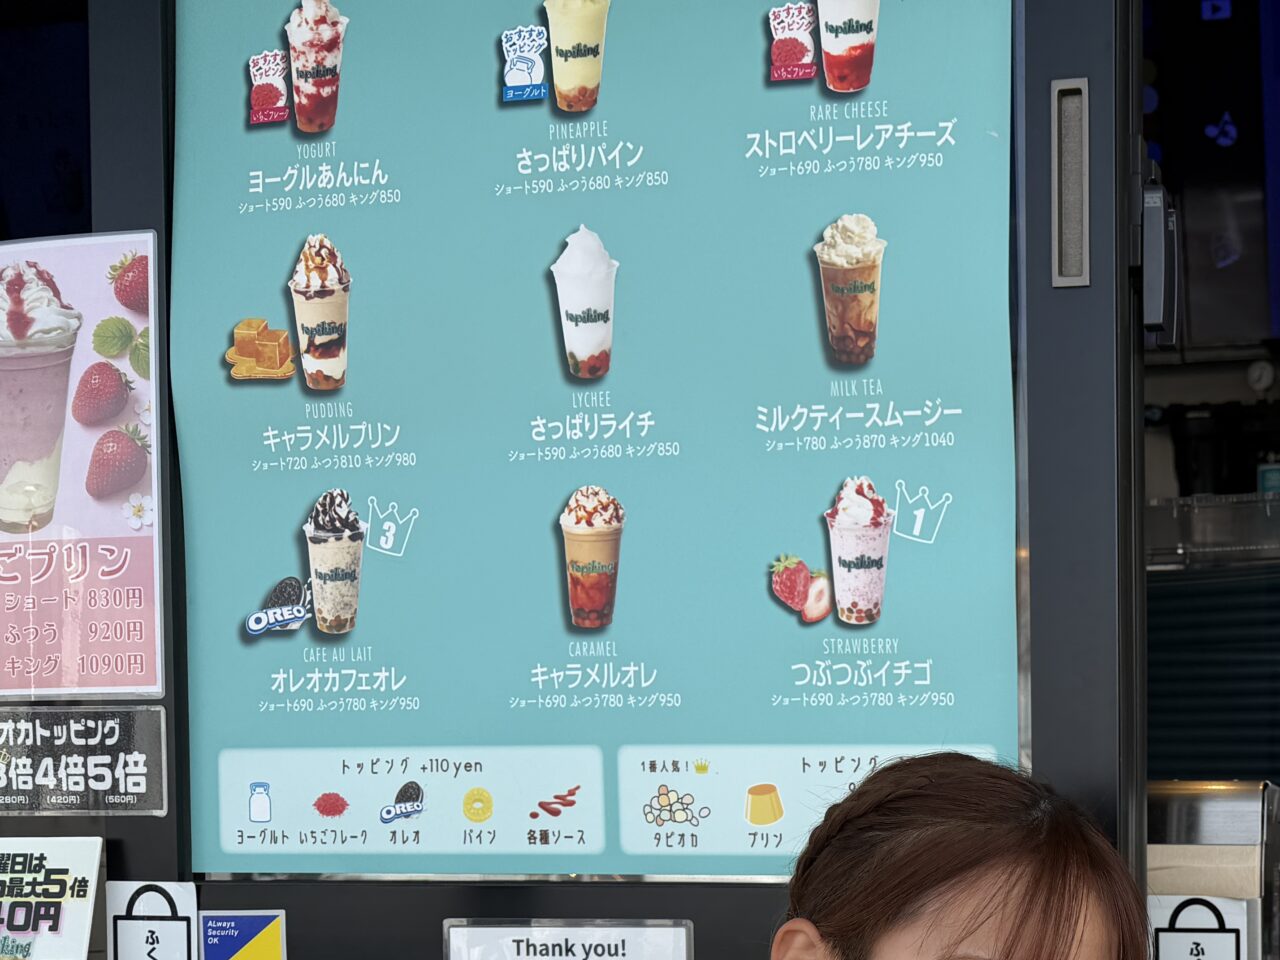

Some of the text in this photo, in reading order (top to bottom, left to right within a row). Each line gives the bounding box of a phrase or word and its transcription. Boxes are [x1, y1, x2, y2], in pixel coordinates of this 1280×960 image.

[770, 5, 815, 20] おすすめ
[772, 18, 815, 33] トッピング
[503, 26, 546, 44] おすすめ
[504, 40, 546, 55] トッピング
[506, 85, 547, 99] ヨーグルト
[810, 101, 888, 120] RARE CHEESE
[549, 120, 608, 140] PINEAPPLE
[745, 118, 957, 159] ストロベリーレアチーズ
[297, 142, 337, 159] YOGURT
[516, 140, 644, 174] さっぱりパイン
[758, 152, 943, 178] ショート690 ふつう780 キング950
[249, 159, 388, 193] ヨーグルあんにん
[494, 171, 669, 196] ショート590 ふつう680 キング850
[238, 189, 400, 215] ショート590 ふつう680 キング850
[830, 379, 883, 397] MILK TEA
[572, 391, 611, 408] LYCHEE
[305, 402, 353, 419] PUDDING
[755, 398, 962, 434] ミルクティースムージー
[530, 410, 655, 442] さっぱりライチ
[262, 422, 400, 452] キャラメルプリン
[765, 431, 954, 452] ショート780 ふつう870 キング1040
[508, 441, 680, 462] ショート590 ふつう680 キング850
[252, 453, 416, 471] ショート720 ふつう810 キング980
[911, 509, 926, 536] 1
[380, 521, 396, 550] 3
[4, 588, 144, 612] ショート 830円
[248, 606, 305, 631] OREO
[5, 620, 144, 644] ふつう 920円
[303, 646, 372, 663] CAFE AU LAIT
[568, 641, 617, 657] CARAMEL
[823, 638, 899, 654] STRAWBERRY
[5, 652, 145, 676] キング 1090円
[791, 659, 933, 687] つぶつぶイチゴ
[271, 667, 407, 693] オレオカフェオレ
[530, 661, 657, 690] キャラメルオレ
[258, 696, 419, 712] ショート690 ふつう780 キング950
[509, 693, 681, 709] ショート690 ふつう780 キング950
[771, 692, 954, 707] ショート690 ふつう780 キング950
[342, 758, 409, 775] トッピング
[381, 801, 423, 820] OREO
[237, 830, 289, 845] ヨーグルト
[299, 830, 367, 845] いちごフレーク
[390, 830, 420, 845] オレオ
[463, 830, 496, 845] パイン
[527, 829, 586, 845] 各種ソース
[653, 833, 698, 848] タピオカ
[749, 833, 783, 849] プリン
[207, 928, 239, 938] Security
[512, 938, 626, 960] Thank you!
